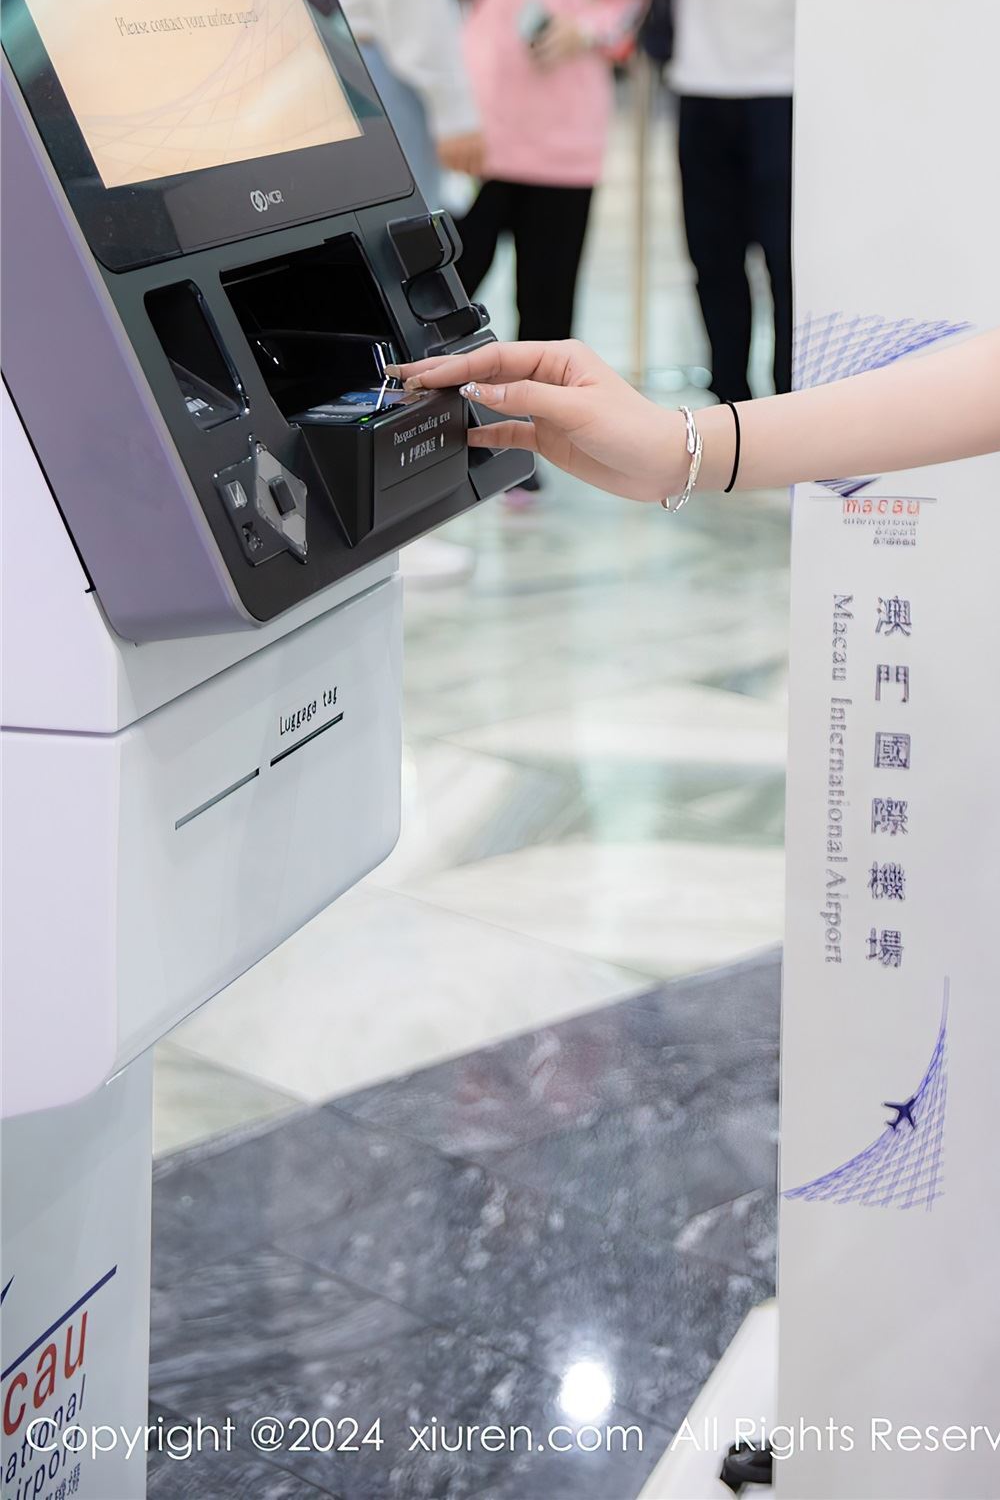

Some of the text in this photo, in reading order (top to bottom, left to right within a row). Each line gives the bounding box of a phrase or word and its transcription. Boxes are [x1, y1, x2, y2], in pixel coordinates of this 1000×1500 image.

[843, 499, 920, 516] macau
[820, 593, 854, 964] Macau International Airport
